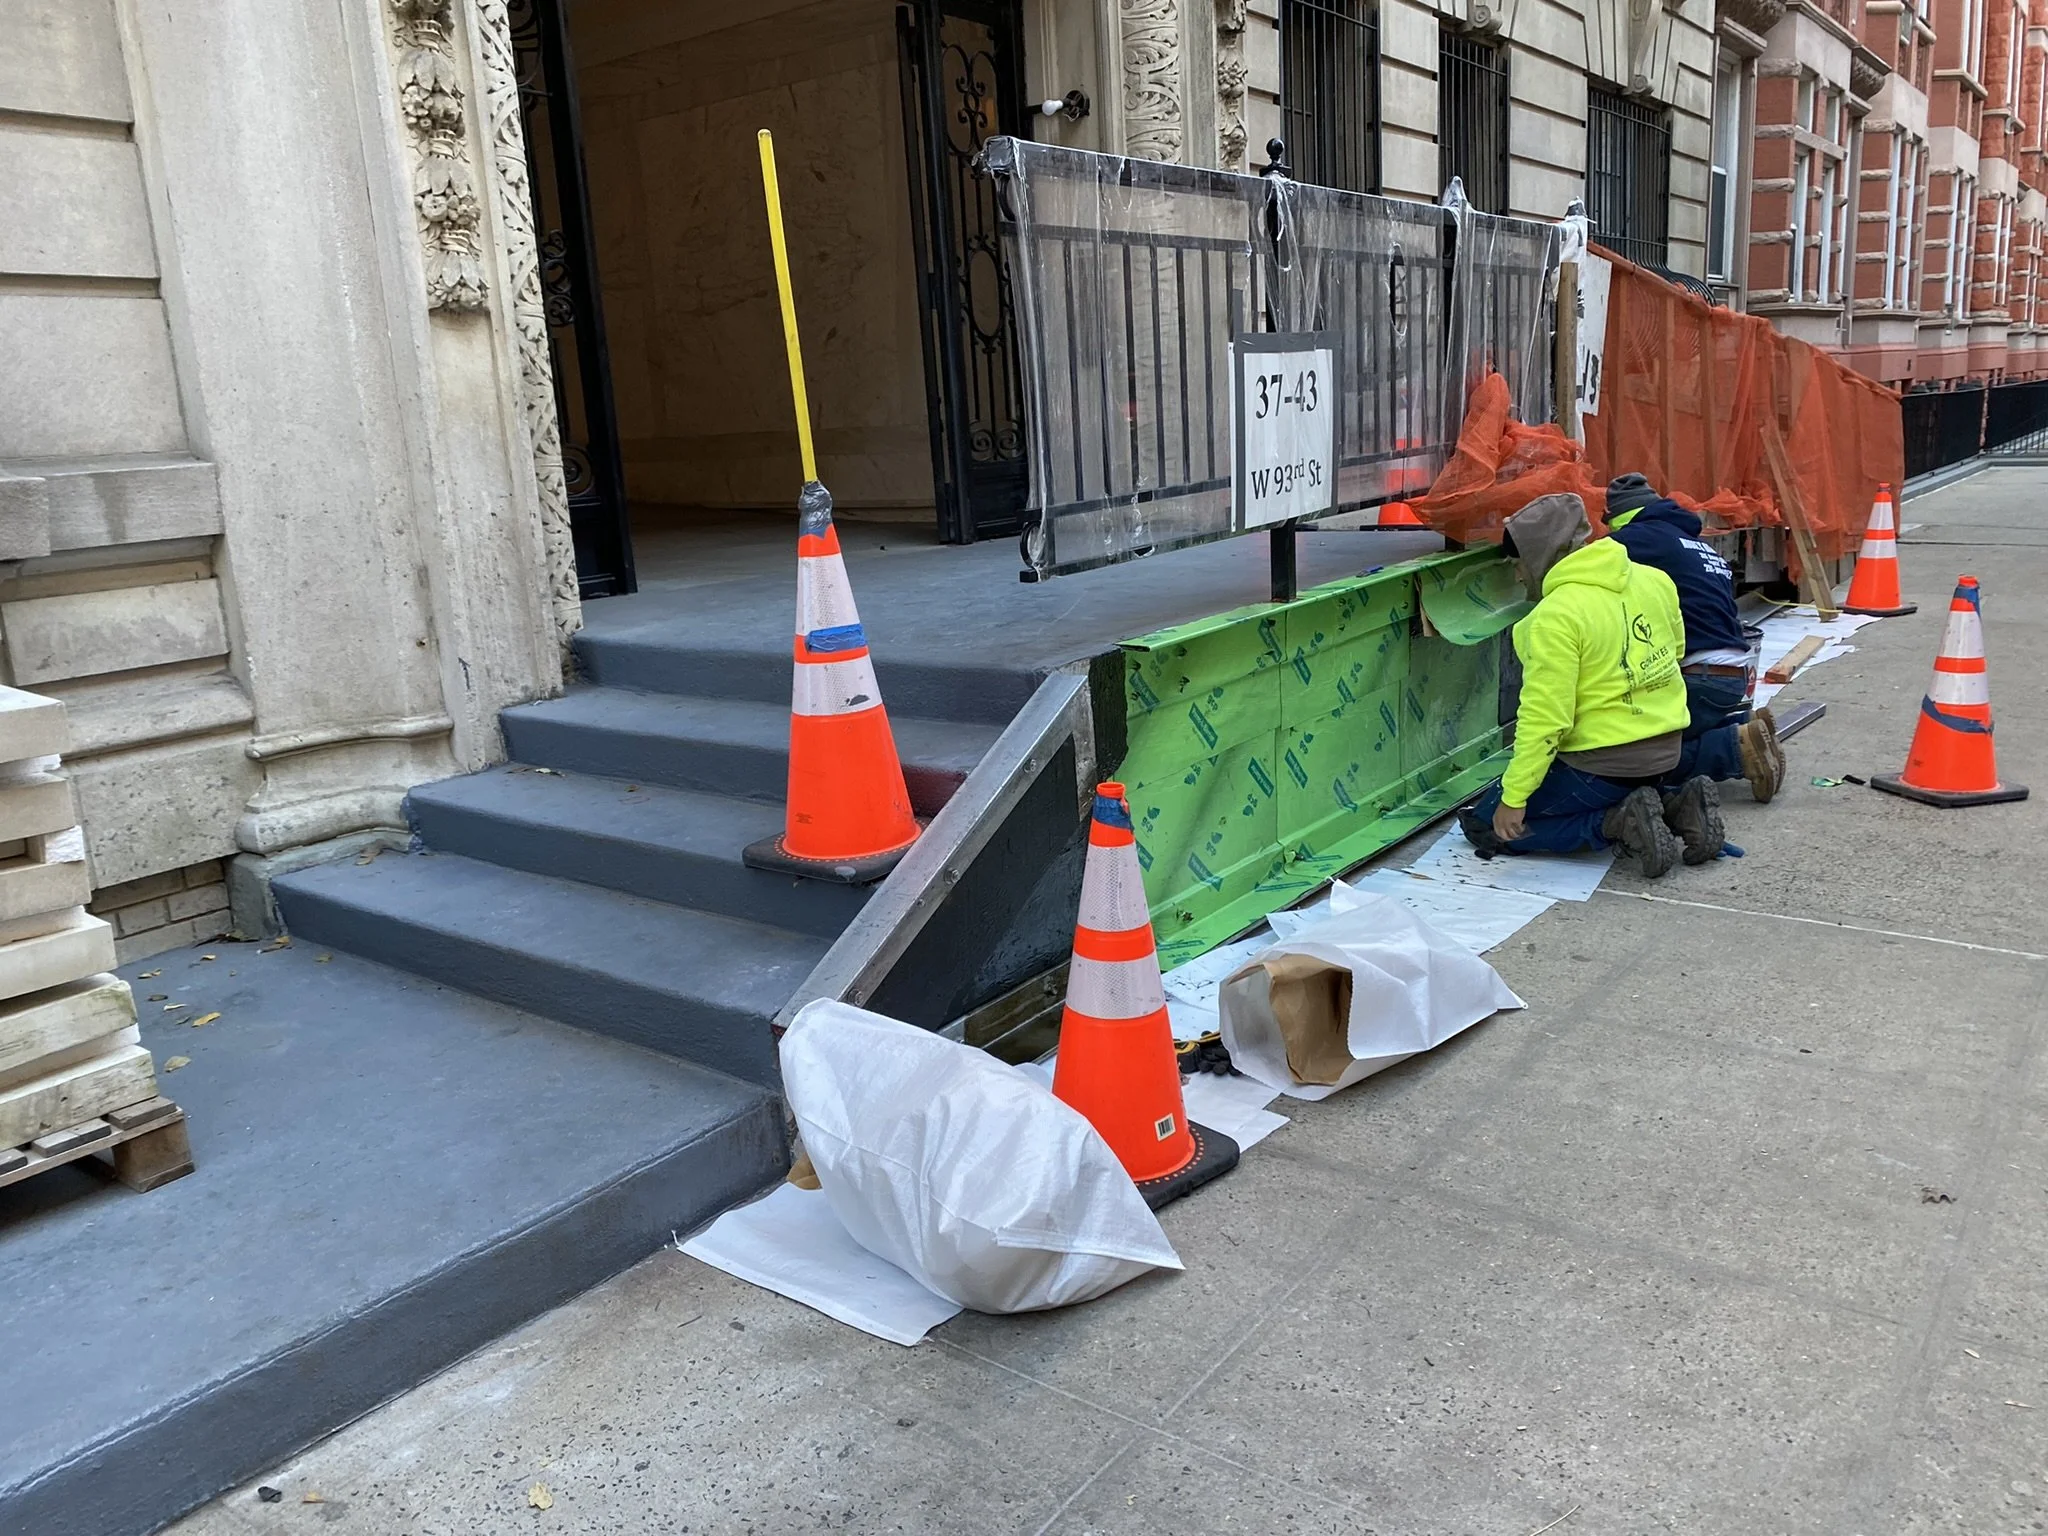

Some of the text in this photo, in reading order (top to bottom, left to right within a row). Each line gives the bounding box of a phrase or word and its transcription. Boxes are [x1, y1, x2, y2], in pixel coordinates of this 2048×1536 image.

[1255, 370, 1318, 419] 37-43
[1251, 458, 1322, 500] W 93rd St
